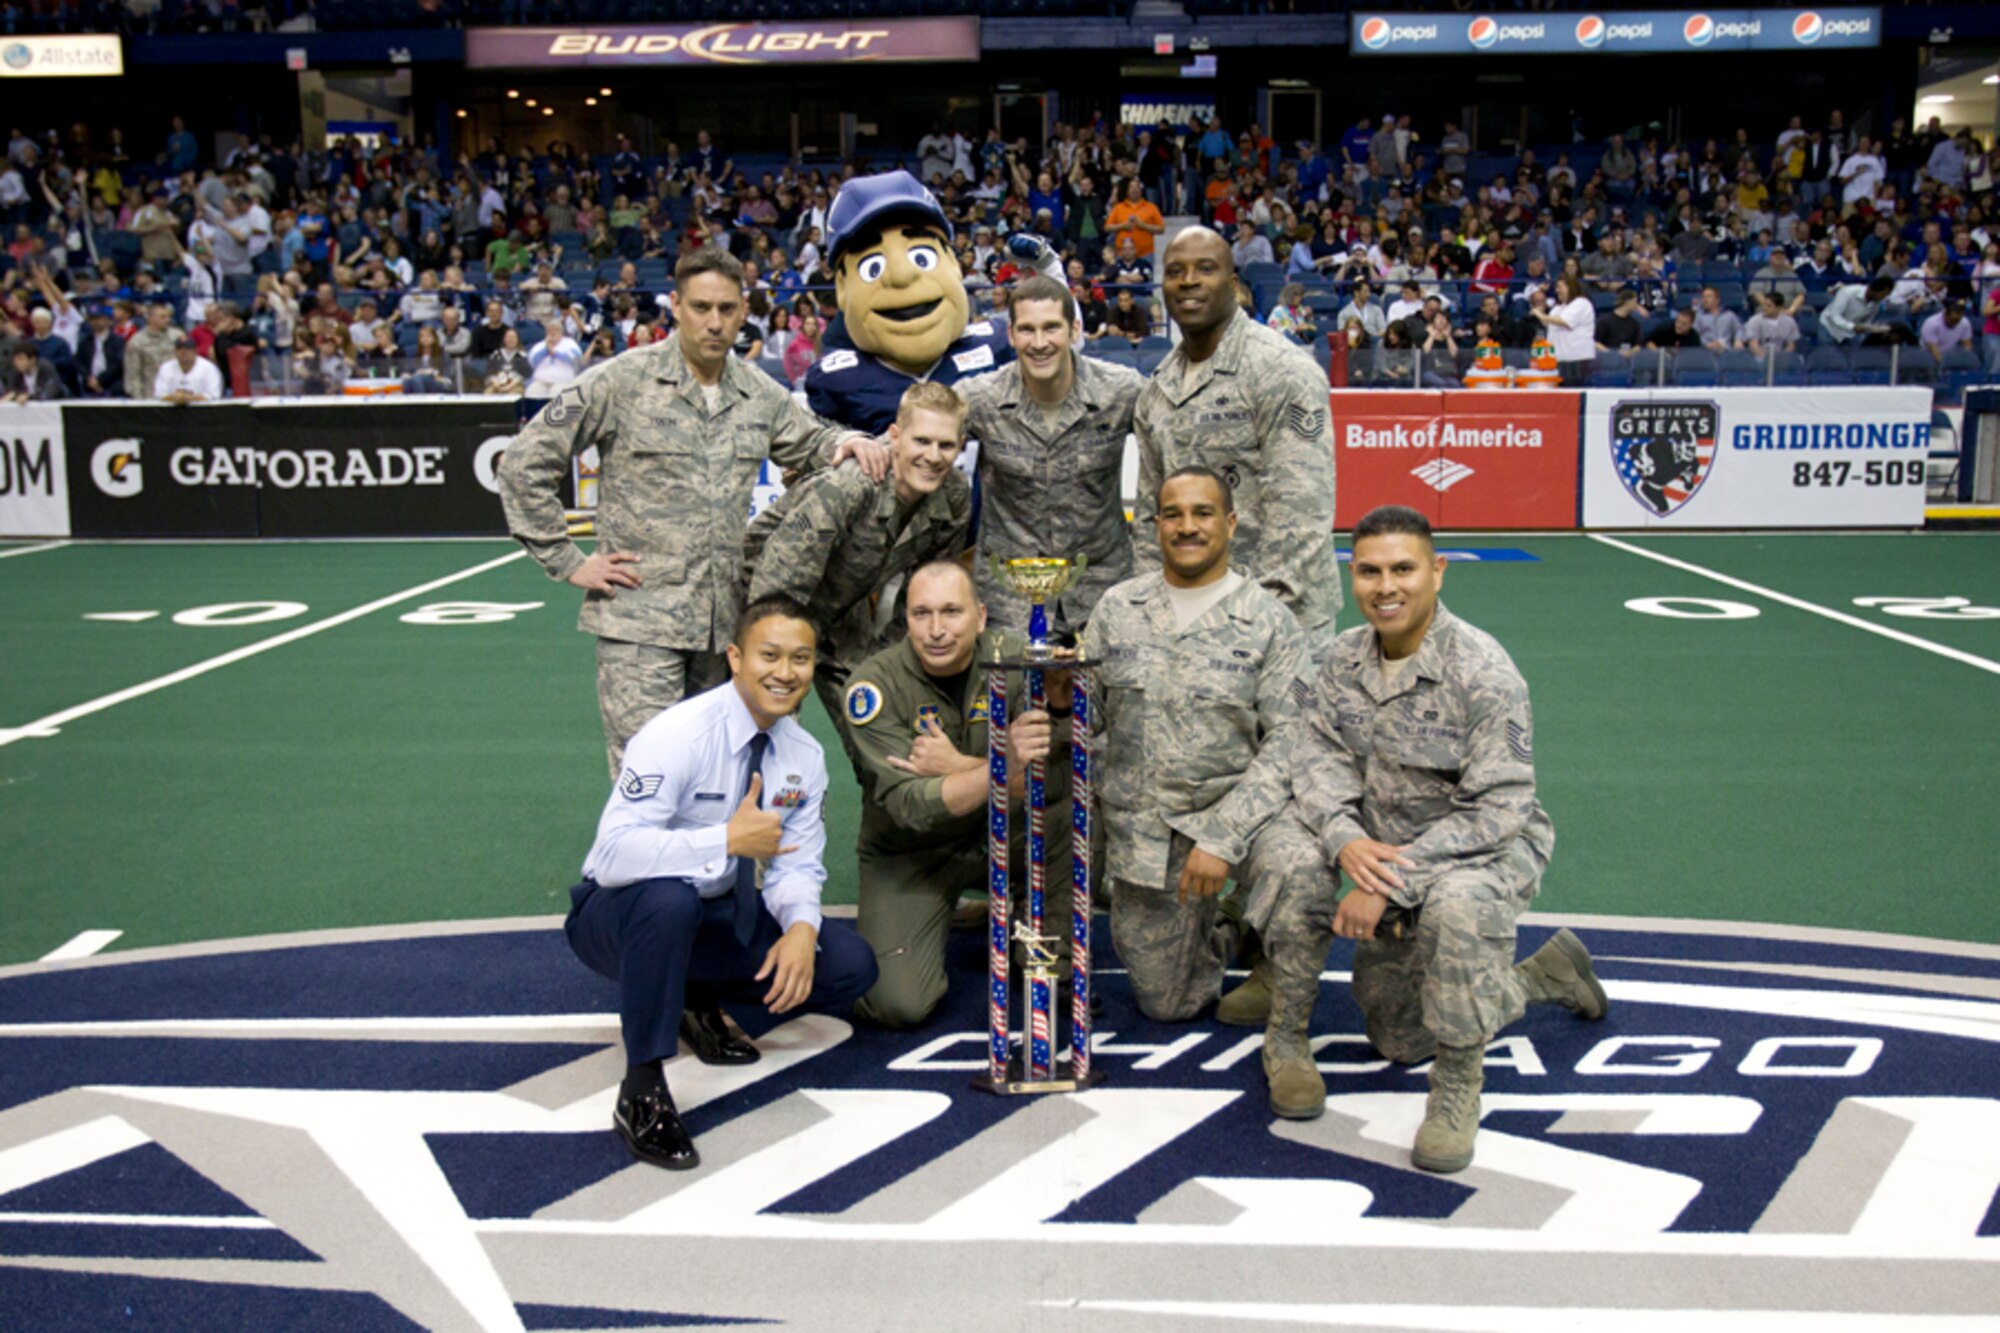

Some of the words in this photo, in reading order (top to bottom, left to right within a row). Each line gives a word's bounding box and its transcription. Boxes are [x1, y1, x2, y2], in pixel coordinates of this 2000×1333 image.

[1392, 24, 1437, 41] pepsi
[1500, 23, 1545, 41] pepsi
[1607, 22, 1652, 40] pepsi
[1715, 20, 1761, 38] pepsi
[1824, 18, 1870, 36] pepsi
[549, 35, 679, 54] BUD
[710, 30, 889, 51] LIGHT
[40, 47, 115, 66] Allstate
[1633, 408, 1700, 418] GRIDIRON
[1618, 418, 1709, 434] GREATS
[1346, 424, 1409, 448] Bank
[1411, 424, 1438, 448] of
[1440, 424, 1543, 448] America
[169, 446, 445, 488] GATORADE
[1793, 461, 1925, 487] 847-509
